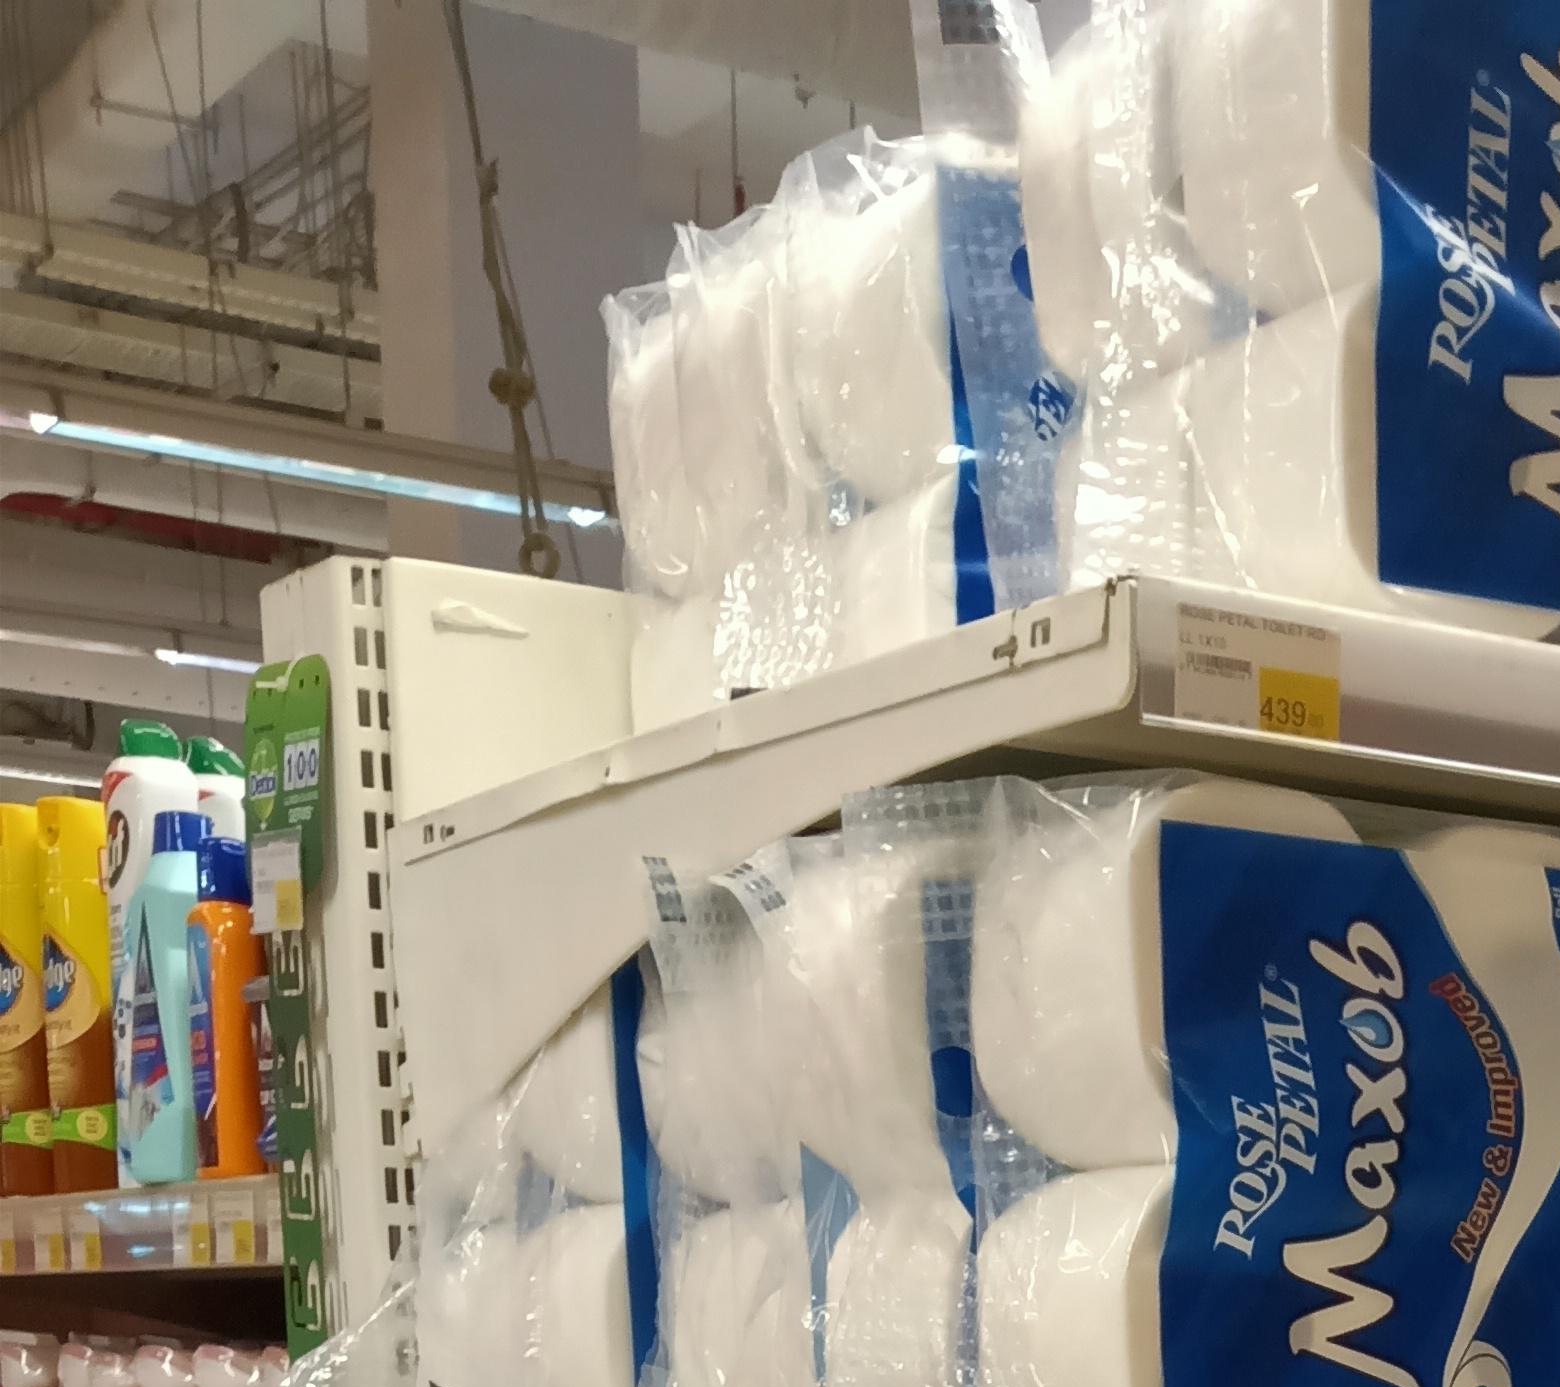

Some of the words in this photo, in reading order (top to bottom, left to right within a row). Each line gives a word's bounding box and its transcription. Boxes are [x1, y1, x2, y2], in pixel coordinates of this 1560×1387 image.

[1428, 205, 1497, 383] ROSE
[1218, 610, 1257, 630] PETAL
[1260, 617, 1302, 637] TOILET
[1260, 697, 1307, 728] 439
[43, 958, 77, 991] dge
[1428, 972, 1521, 1140] Improved
[1213, 1095, 1288, 1260] ROSE
[1259, 981, 1319, 1176] PETAL
[1483, 1144, 1512, 1175] &
[1449, 1176, 1496, 1264] New
